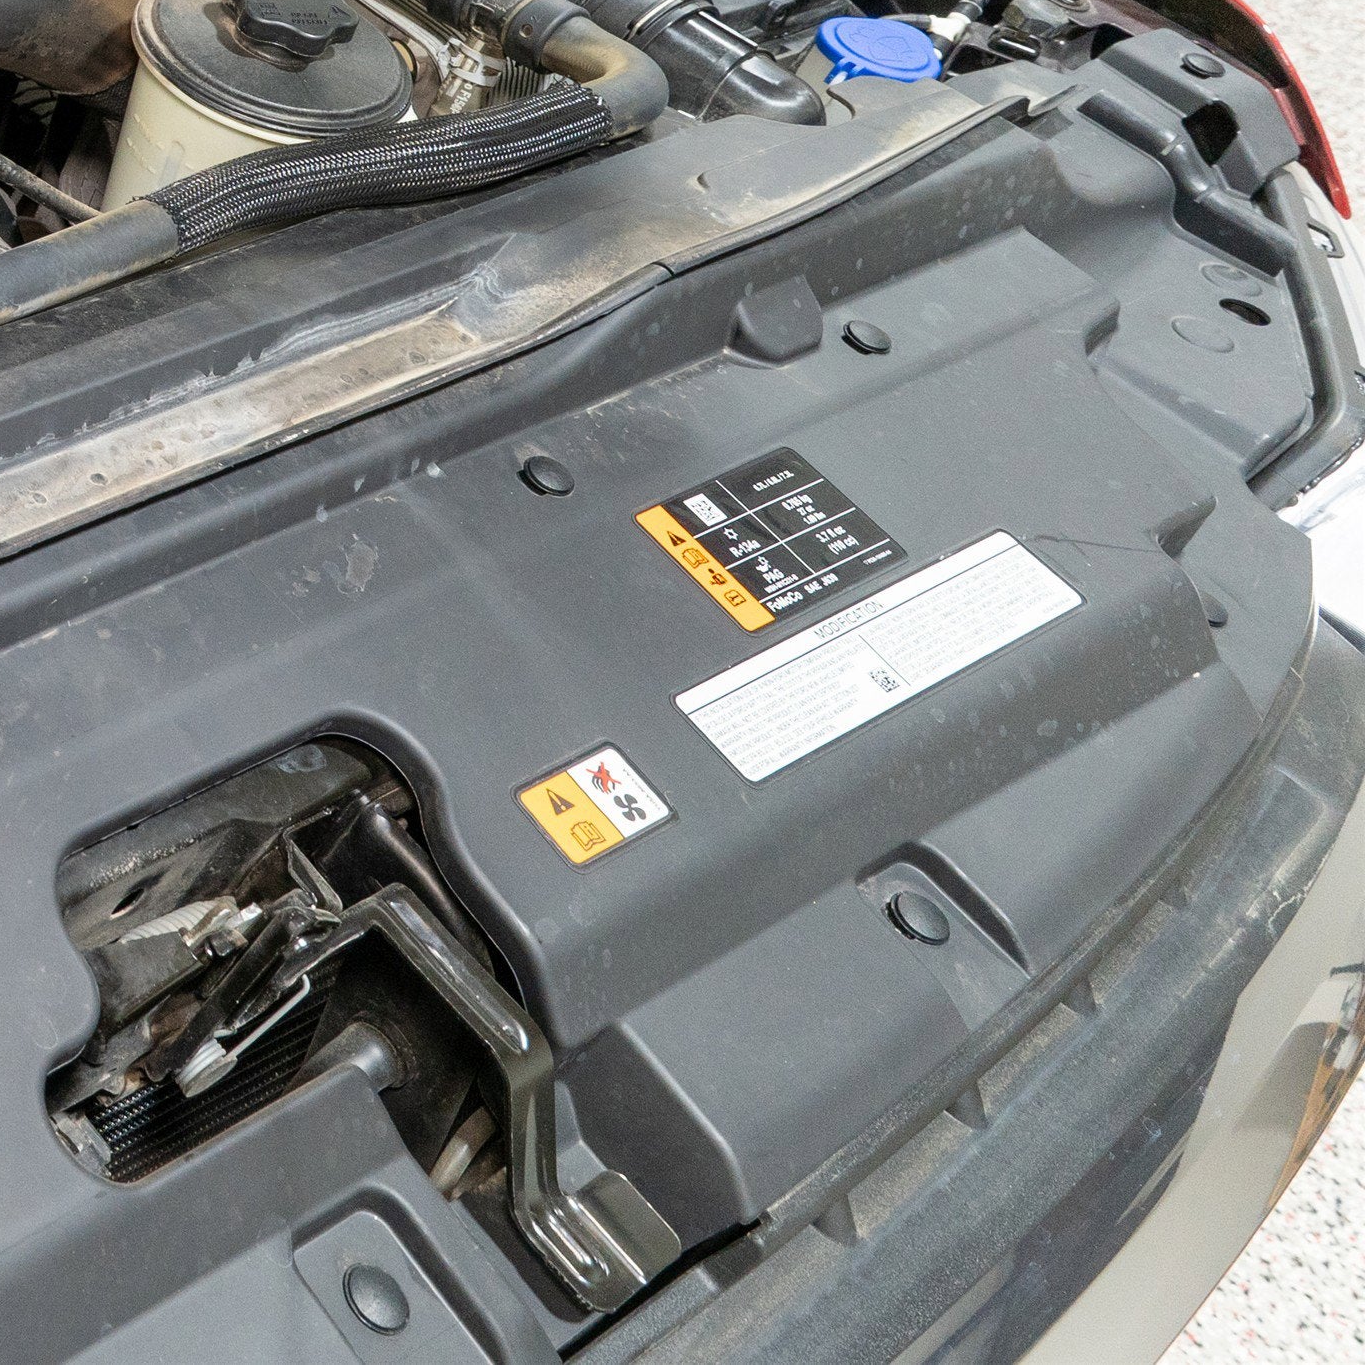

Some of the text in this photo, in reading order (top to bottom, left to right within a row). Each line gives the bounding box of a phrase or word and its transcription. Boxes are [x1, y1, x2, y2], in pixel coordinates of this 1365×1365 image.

[730, 540, 760, 557] R-134a
[762, 568, 784, 583] PAG
[766, 591, 803, 612] FoMoCo
[804, 581, 822, 594] SAE
[814, 600, 884, 639] MODIFICATION
